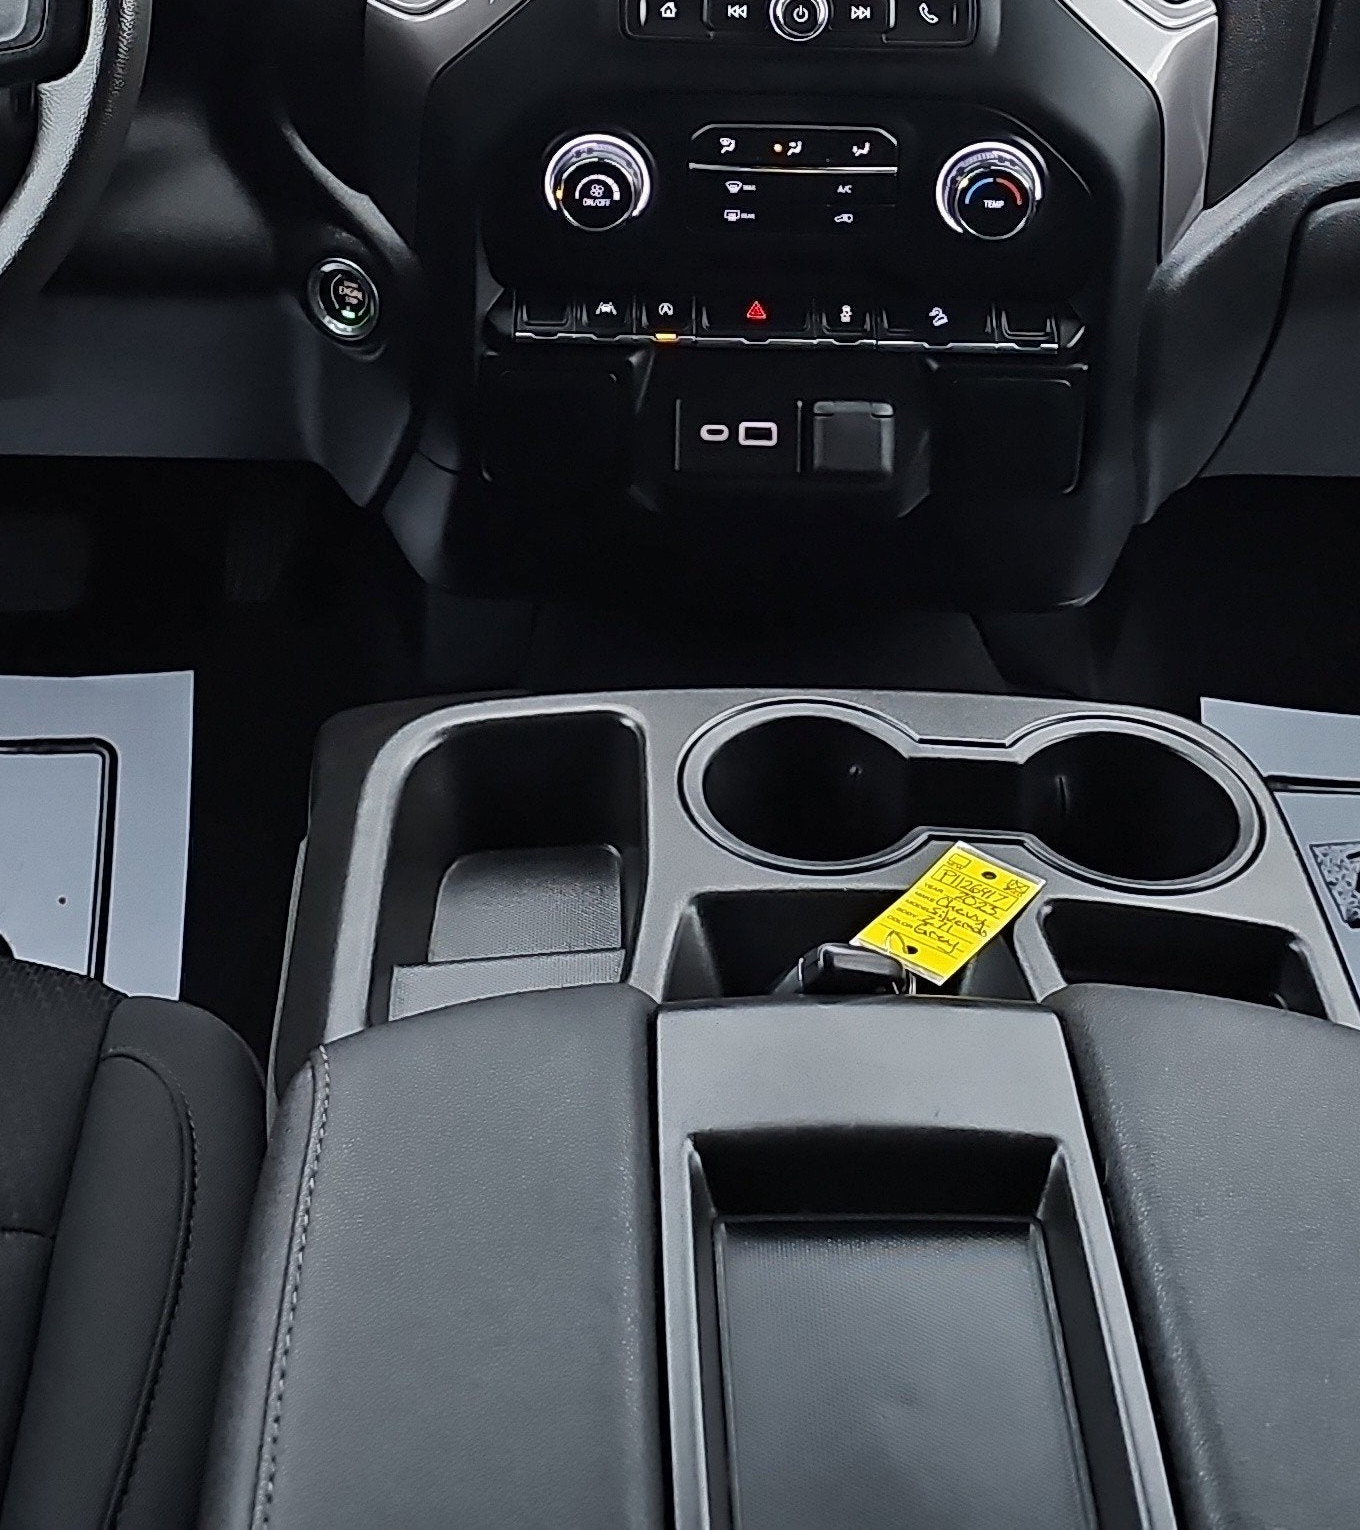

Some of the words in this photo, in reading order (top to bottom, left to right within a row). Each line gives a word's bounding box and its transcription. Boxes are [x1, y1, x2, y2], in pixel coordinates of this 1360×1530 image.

[836, 184, 853, 194] A/C
[582, 197, 612, 207] ON/OFF
[982, 199, 1005, 209] TEMP
[924, 882, 944, 894] YEAR
[953, 892, 998, 917] 2023
